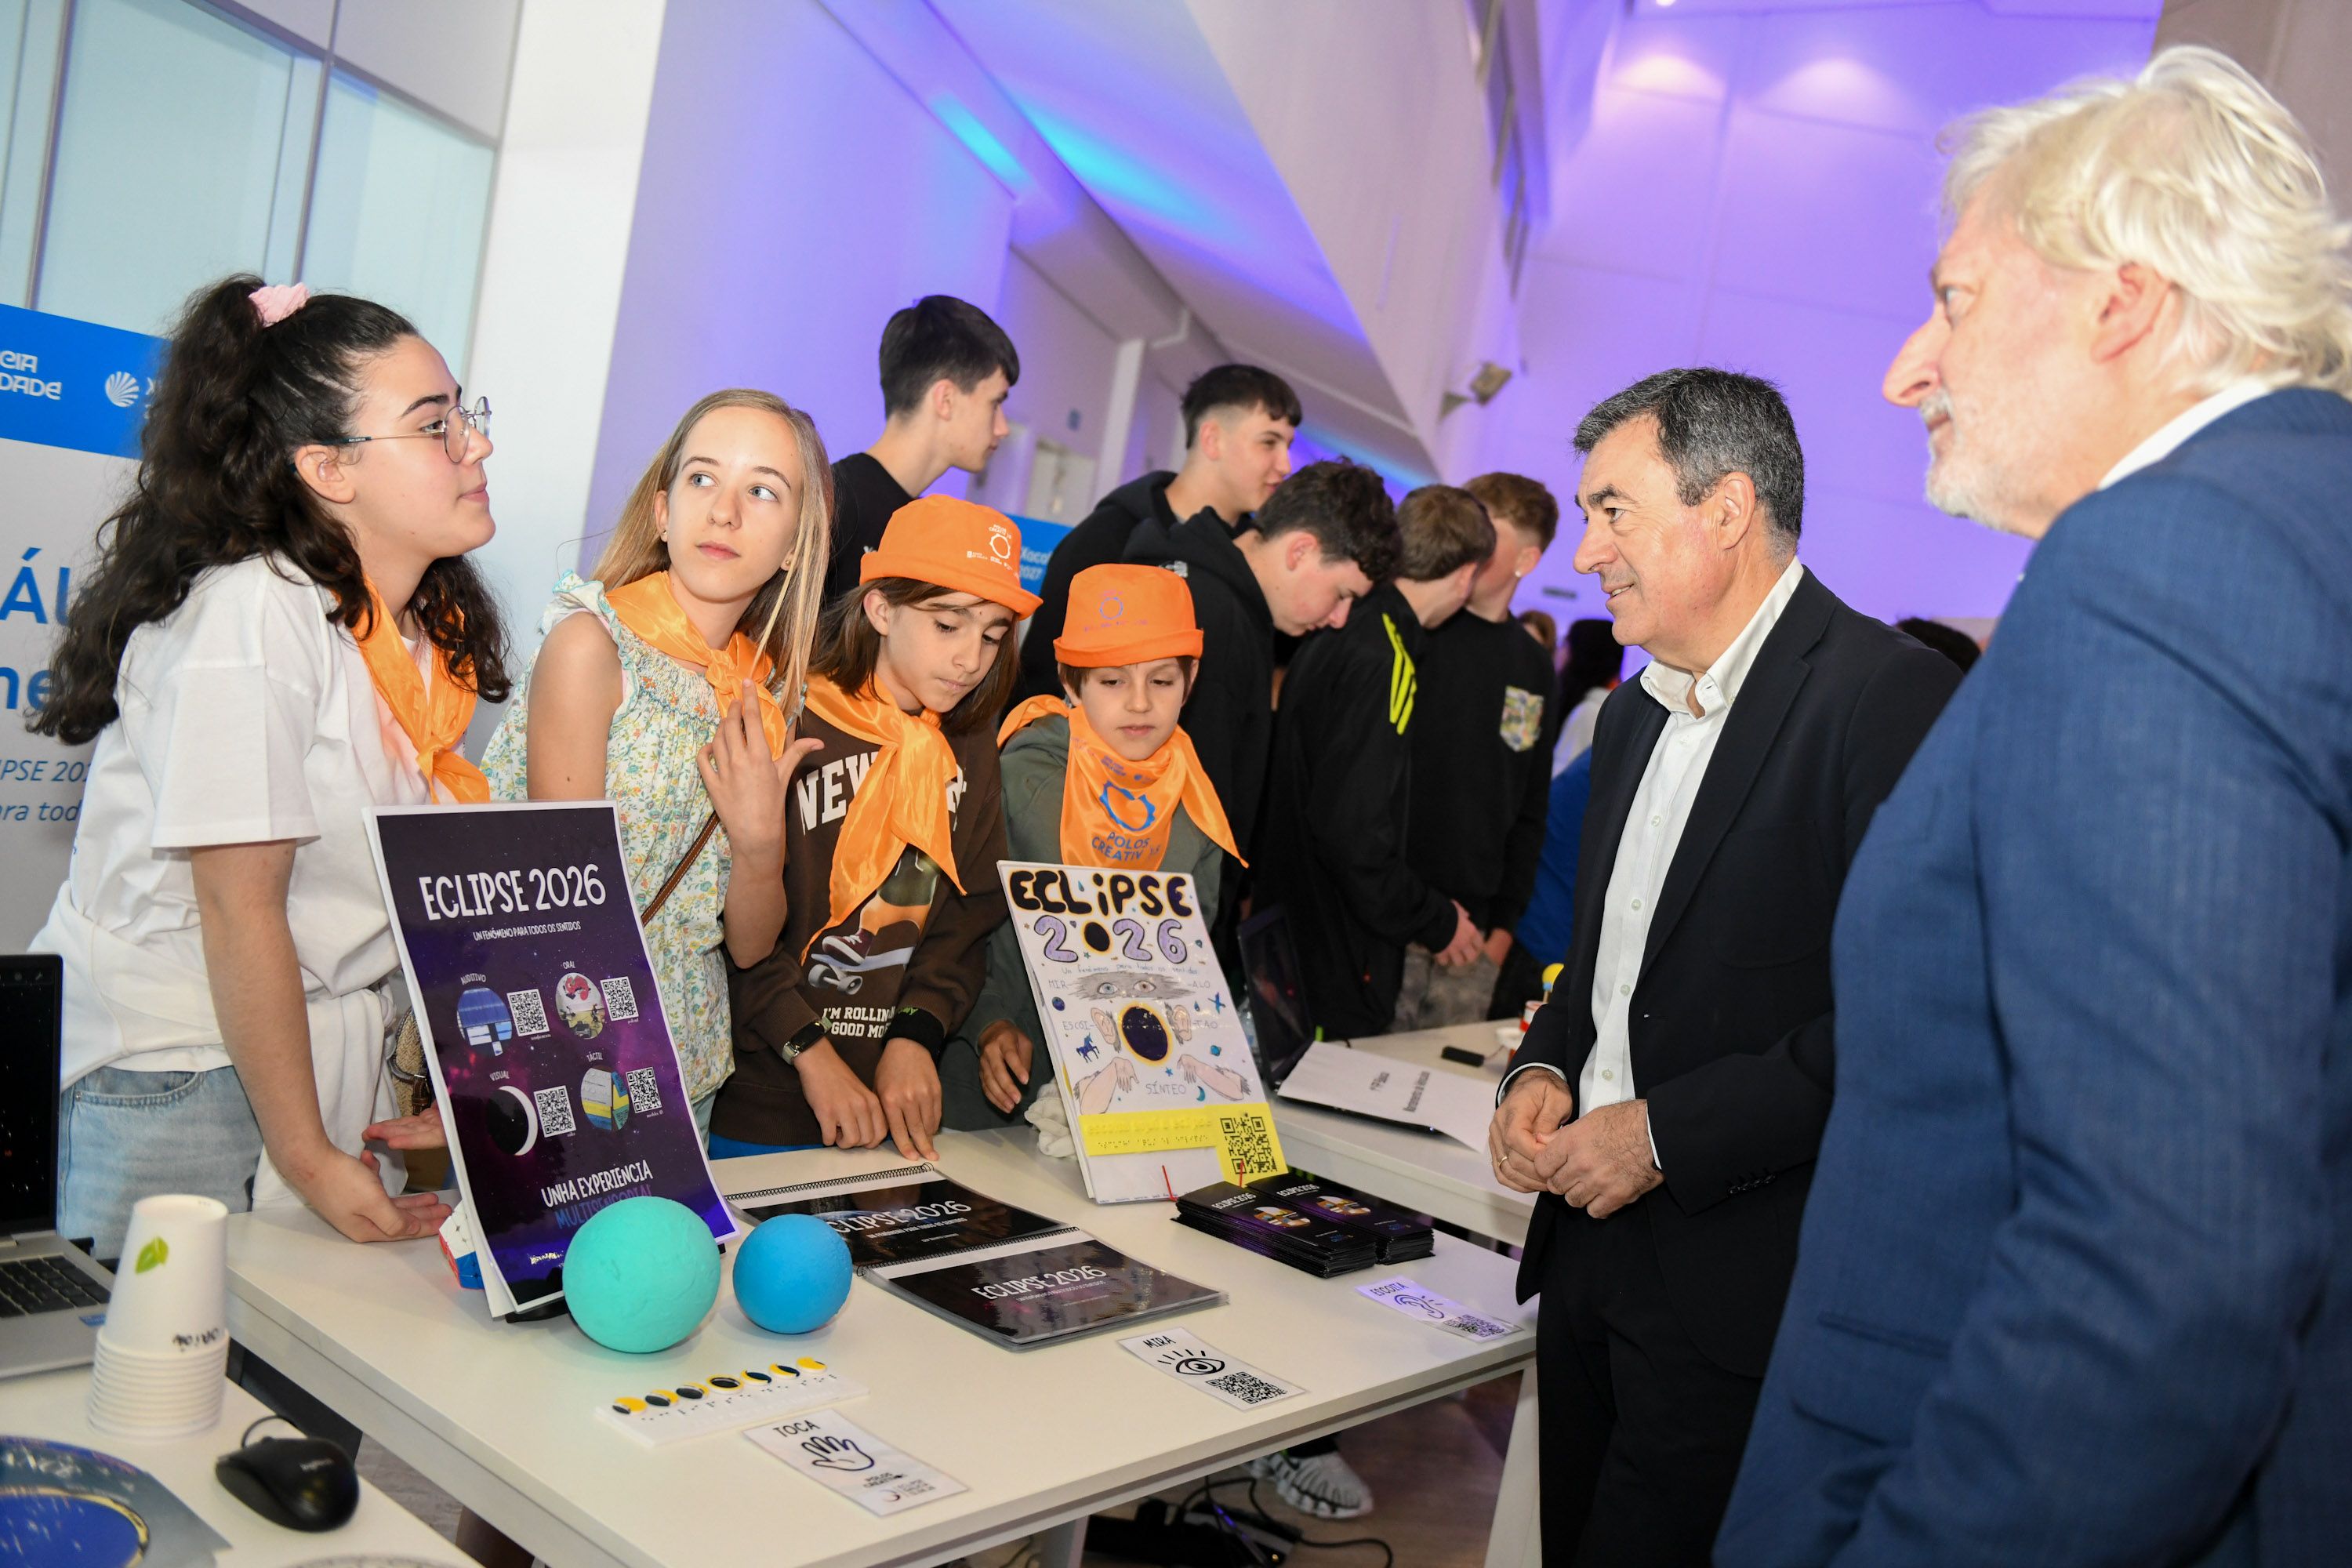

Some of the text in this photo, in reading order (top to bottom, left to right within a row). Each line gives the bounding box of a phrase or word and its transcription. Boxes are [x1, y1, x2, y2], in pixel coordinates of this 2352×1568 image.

[0, 759, 49, 782] PSE
[419, 863, 606, 920] ECLIPSE 2026
[472, 931, 484, 942] UN
[512, 926, 530, 938] PARA
[526, 924, 548, 935] TODOS
[546, 923, 557, 934] OS
[556, 920, 582, 932] SENTIDOS
[1033, 914, 1188, 964] 2026
[562, 960, 576, 970] ORAL
[460, 972, 487, 985] AUDITIVO
[831, 1022, 865, 1037] GOOD
[489, 1070, 510, 1082] VISUAL
[540, 1159, 654, 1208] UNHA EXPERIENCIA
[826, 1200, 972, 1234] CLIPSE 2026
[970, 1276, 1056, 1301] ECLIPSE
[1043, 1265, 1107, 1285] 2026
[1369, 1281, 1410, 1298] ESCOITA
[1142, 1334, 1177, 1348] MIRA
[772, 1419, 821, 1438] TOCA
